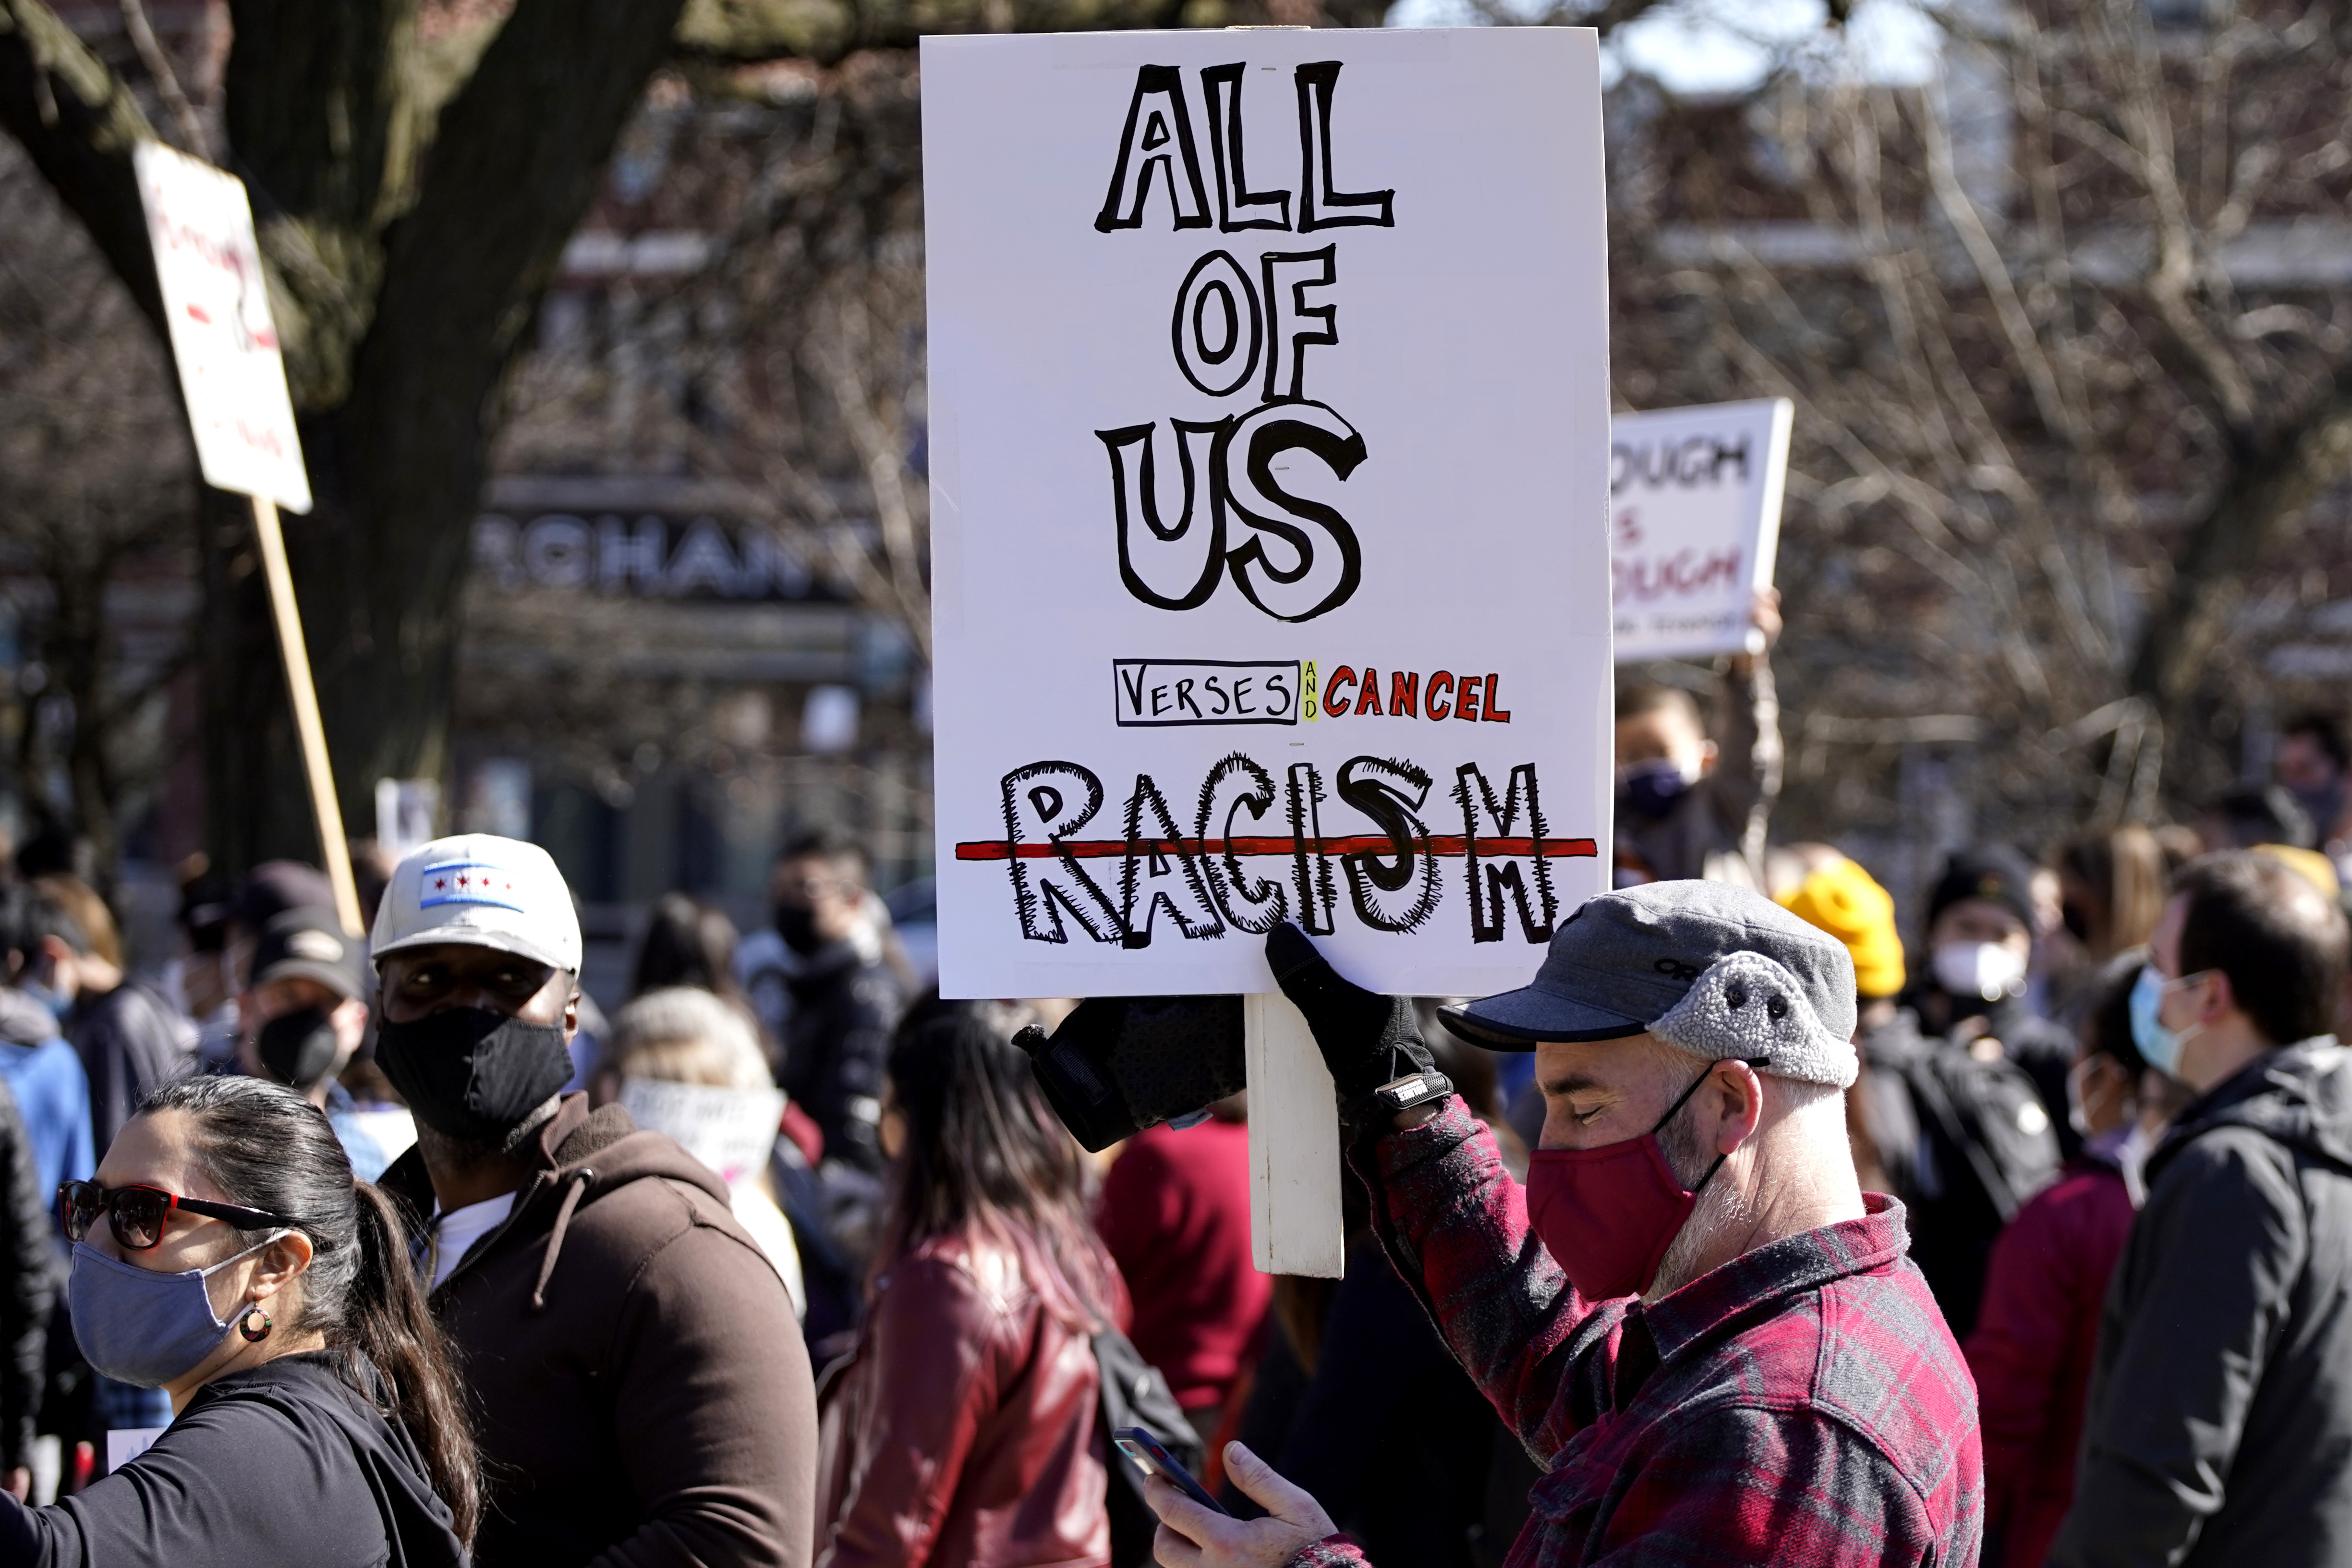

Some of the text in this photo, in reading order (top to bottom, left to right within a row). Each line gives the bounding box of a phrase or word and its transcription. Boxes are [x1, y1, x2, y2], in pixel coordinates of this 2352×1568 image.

[1094, 61, 1395, 233] ALL
[1172, 243, 1338, 403] OF
[1094, 396, 1368, 623] US
[1122, 661, 1511, 723] VERSES AND CANCEL
[1001, 750, 1559, 949] RACISM
[1398, 1083, 1429, 1102] HOLMES
